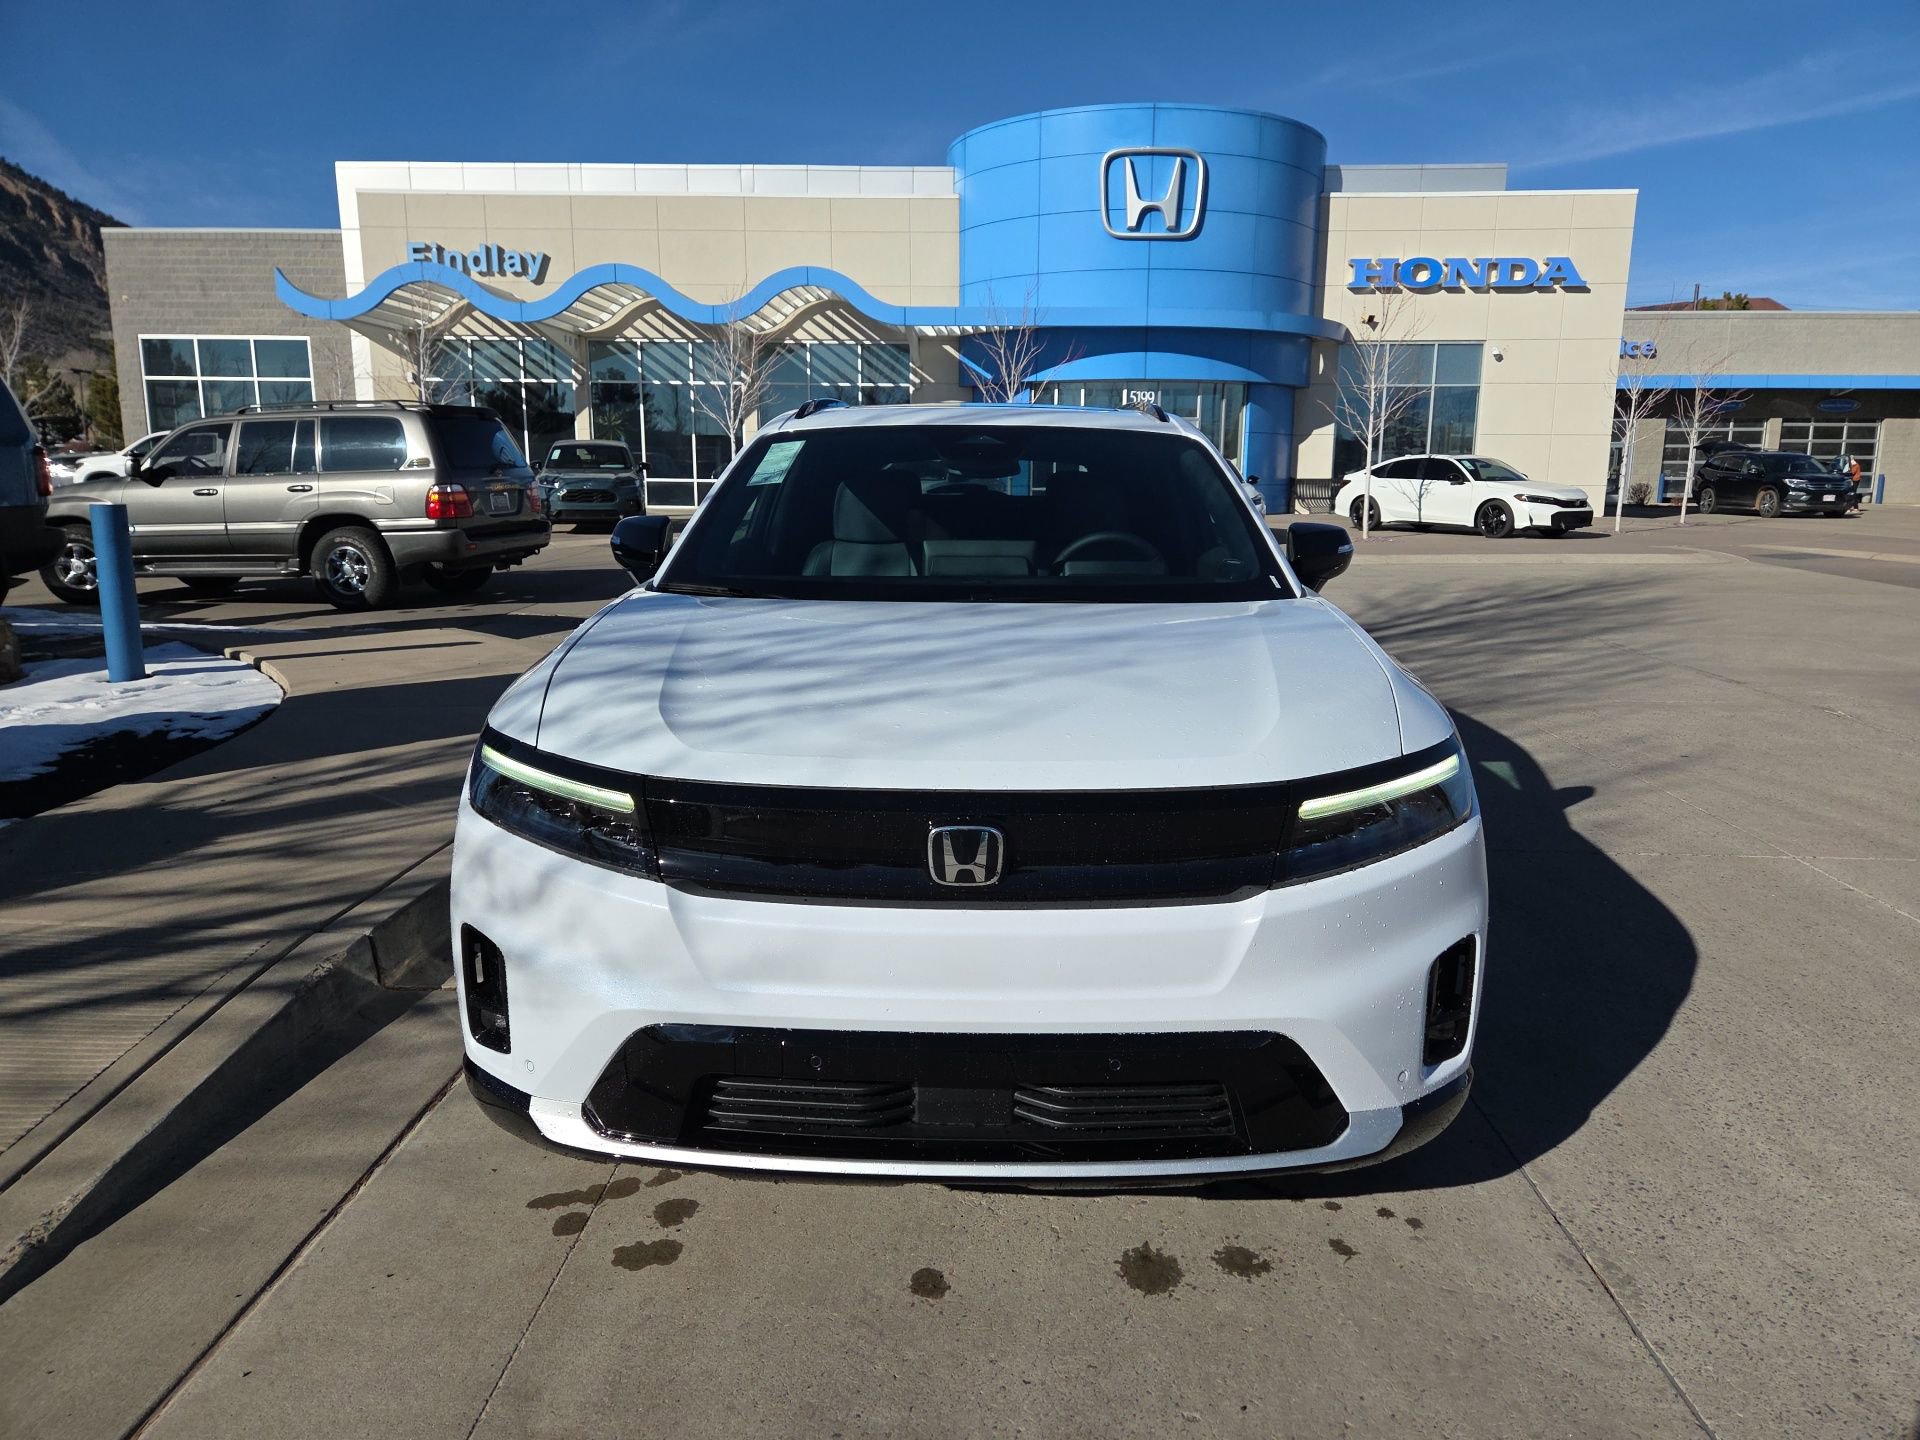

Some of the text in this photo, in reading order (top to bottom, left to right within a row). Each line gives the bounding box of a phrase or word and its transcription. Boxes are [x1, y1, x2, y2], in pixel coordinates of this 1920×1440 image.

[406, 241, 544, 281] Findlay
[1347, 257, 1588, 288] HONDA
[1129, 391, 1155, 404] 5199
